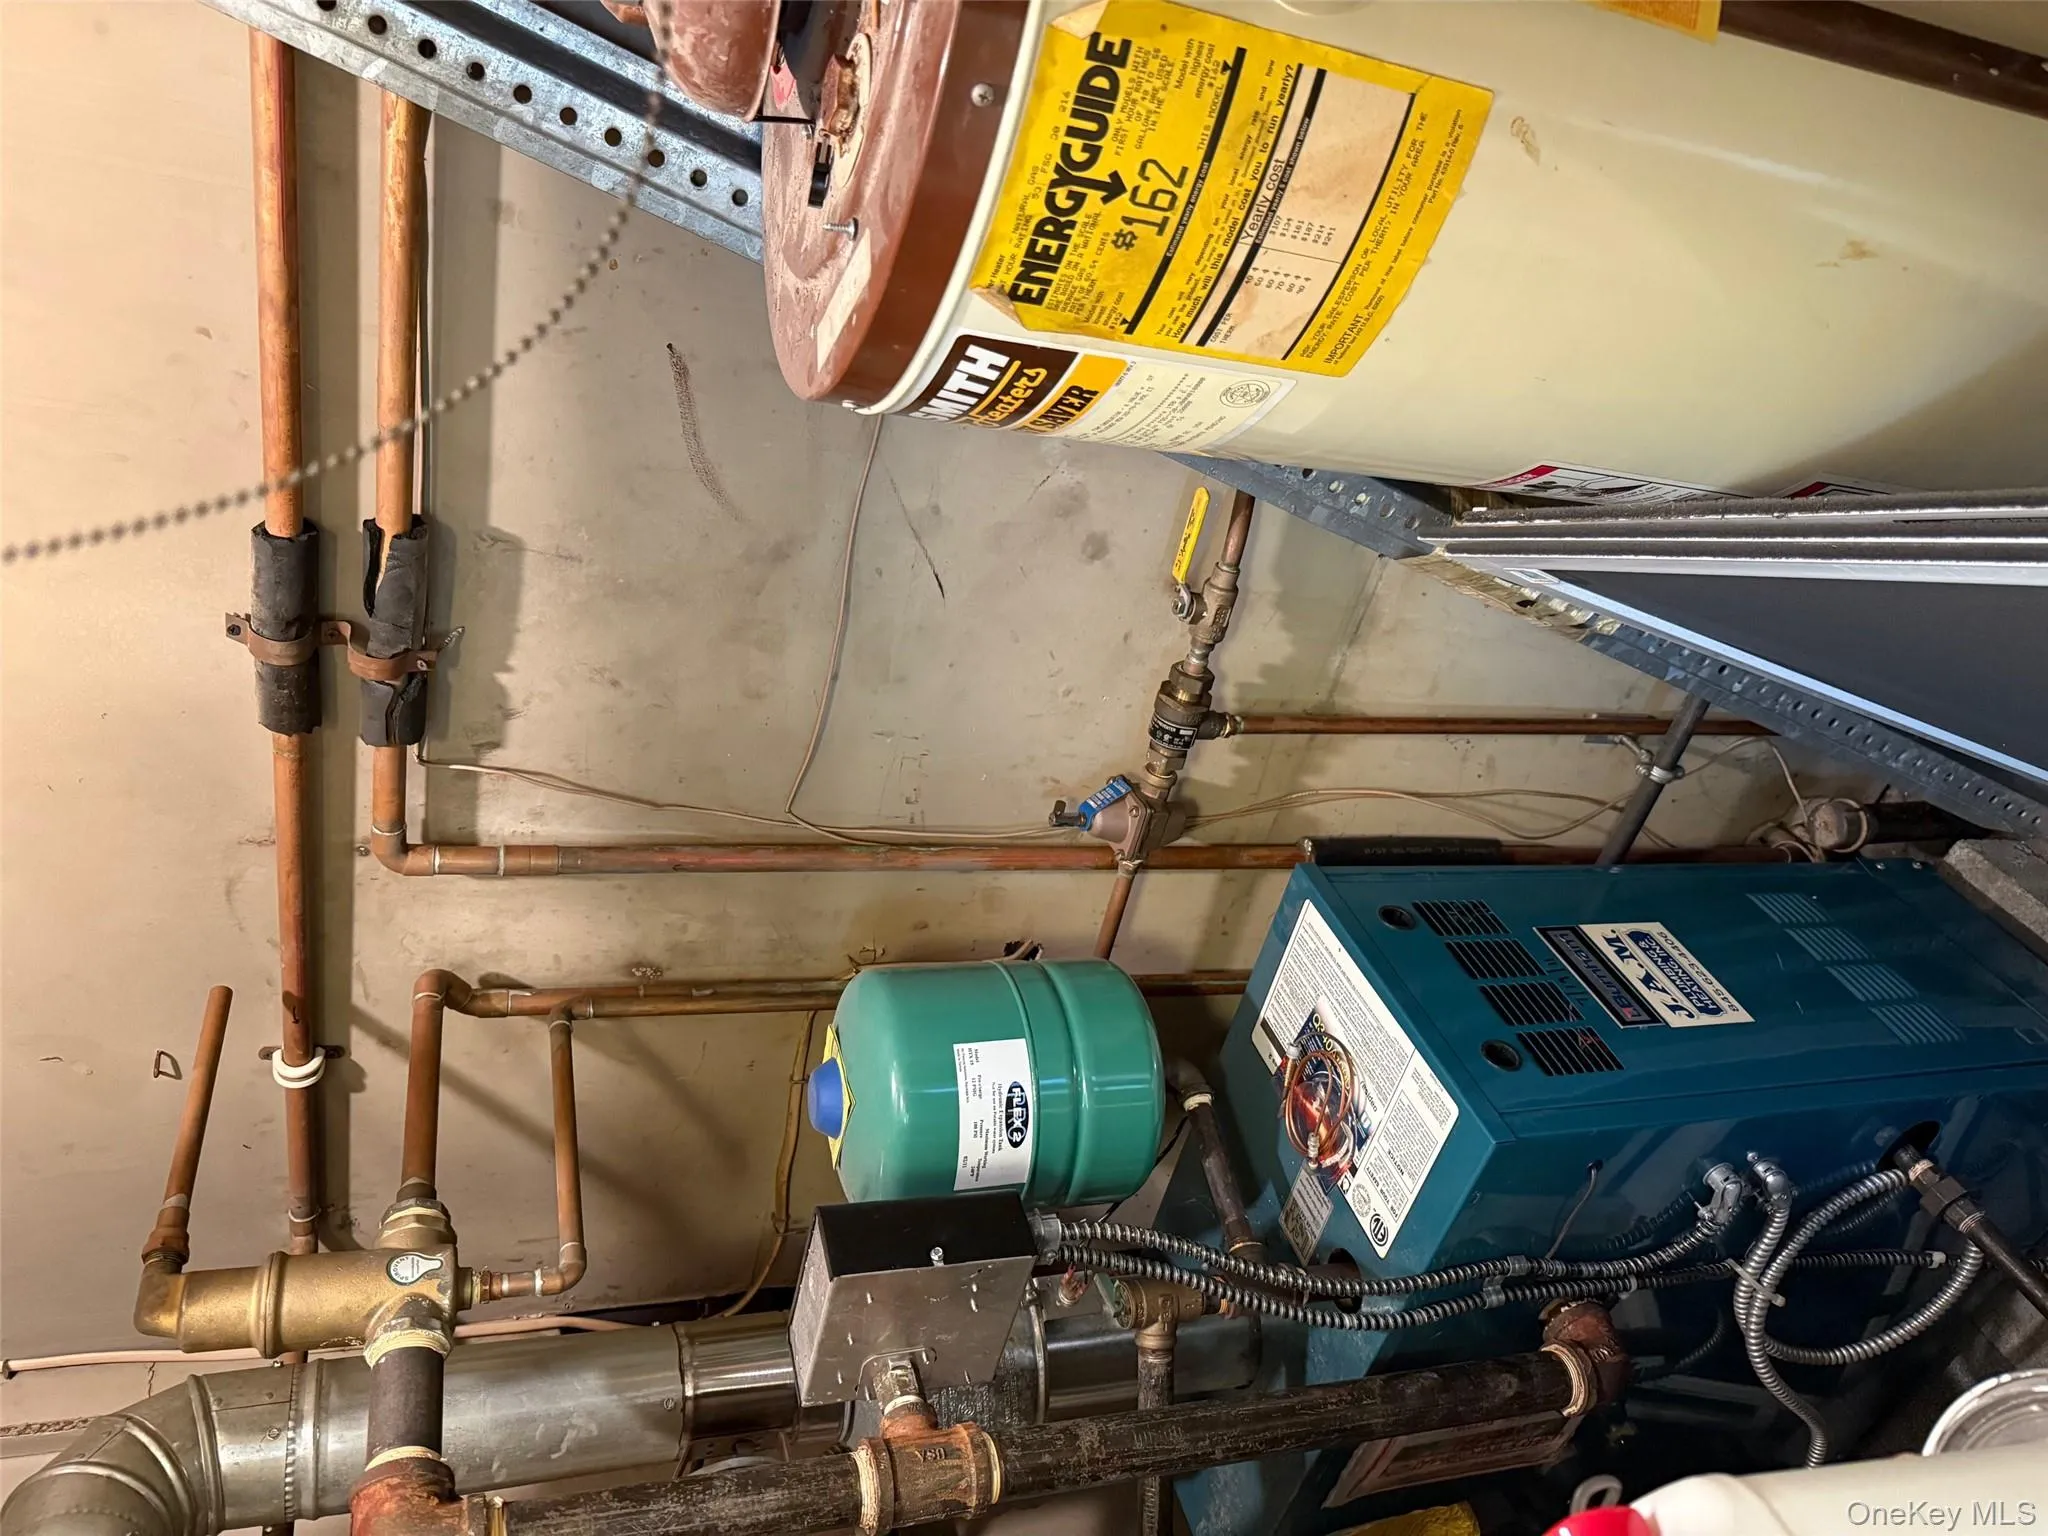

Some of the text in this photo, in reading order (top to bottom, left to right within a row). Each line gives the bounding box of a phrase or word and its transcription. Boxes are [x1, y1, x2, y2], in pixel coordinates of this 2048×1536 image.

[1174, 38, 1194, 89] Model with
[1188, 40, 1205, 76] highest
[1195, 44, 1214, 98] energy cost
[1009, 33, 1130, 306] ENERGYGUIDE
[1172, 65, 1295, 338] How much will this model cost you to run yearly?
[1193, 233, 1213, 266] depending
[1238, 135, 1253, 160] energy
[1257, 86, 1267, 101] and
[1264, 59, 1275, 77] how
[1241, 158, 1285, 242] Yearly cost
[1254, 211, 1274, 244] Estimated
[1271, 190, 1283, 209] yearly
[1281, 166, 1291, 182] cost
[1287, 141, 1300, 165] shown
[1297, 117, 1309, 139] below
[1427, 190, 1437, 204] Part
[991, 254, 1005, 276] Heater
[1010, 193, 1030, 233] NATURAL
[1110, 159, 1188, 250] $162
[1165, 162, 1208, 256] Estimated yearly energy cost
[1311, 225, 1325, 244] $214
[1323, 315, 1363, 363] IMPORTANT
[1411, 194, 1428, 224] consumer
[1425, 160, 1444, 190] purchase
[1446, 108, 1461, 138] violation
[1325, 264, 1362, 319] SALESPERSON
[1360, 248, 1369, 259] OR
[1368, 214, 1386, 243] LOCAL
[1384, 164, 1408, 208] UTILITY
[1404, 139, 1418, 159] FOR
[1416, 112, 1427, 131] THE
[1325, 310, 1343, 329] RATE
[1359, 260, 1371, 276] PER
[1390, 203, 1400, 214] IN
[1397, 173, 1412, 198] YOUR
[1410, 140, 1425, 167] AREA
[1030, 385, 1099, 429] SAVER
[1555, 933, 1634, 1007] Burnham
[1593, 929, 1696, 1019] J.A.M.
[1635, 940, 1706, 1006] PLUMBING &
[1640, 935, 1719, 1008] HEATING, INC.
[1654, 931, 1741, 1012] 845-623-4406
[1365, 1164, 1398, 1219] FOR YOUR SAFETY
[1386, 1147, 1404, 1176] NOTICE
